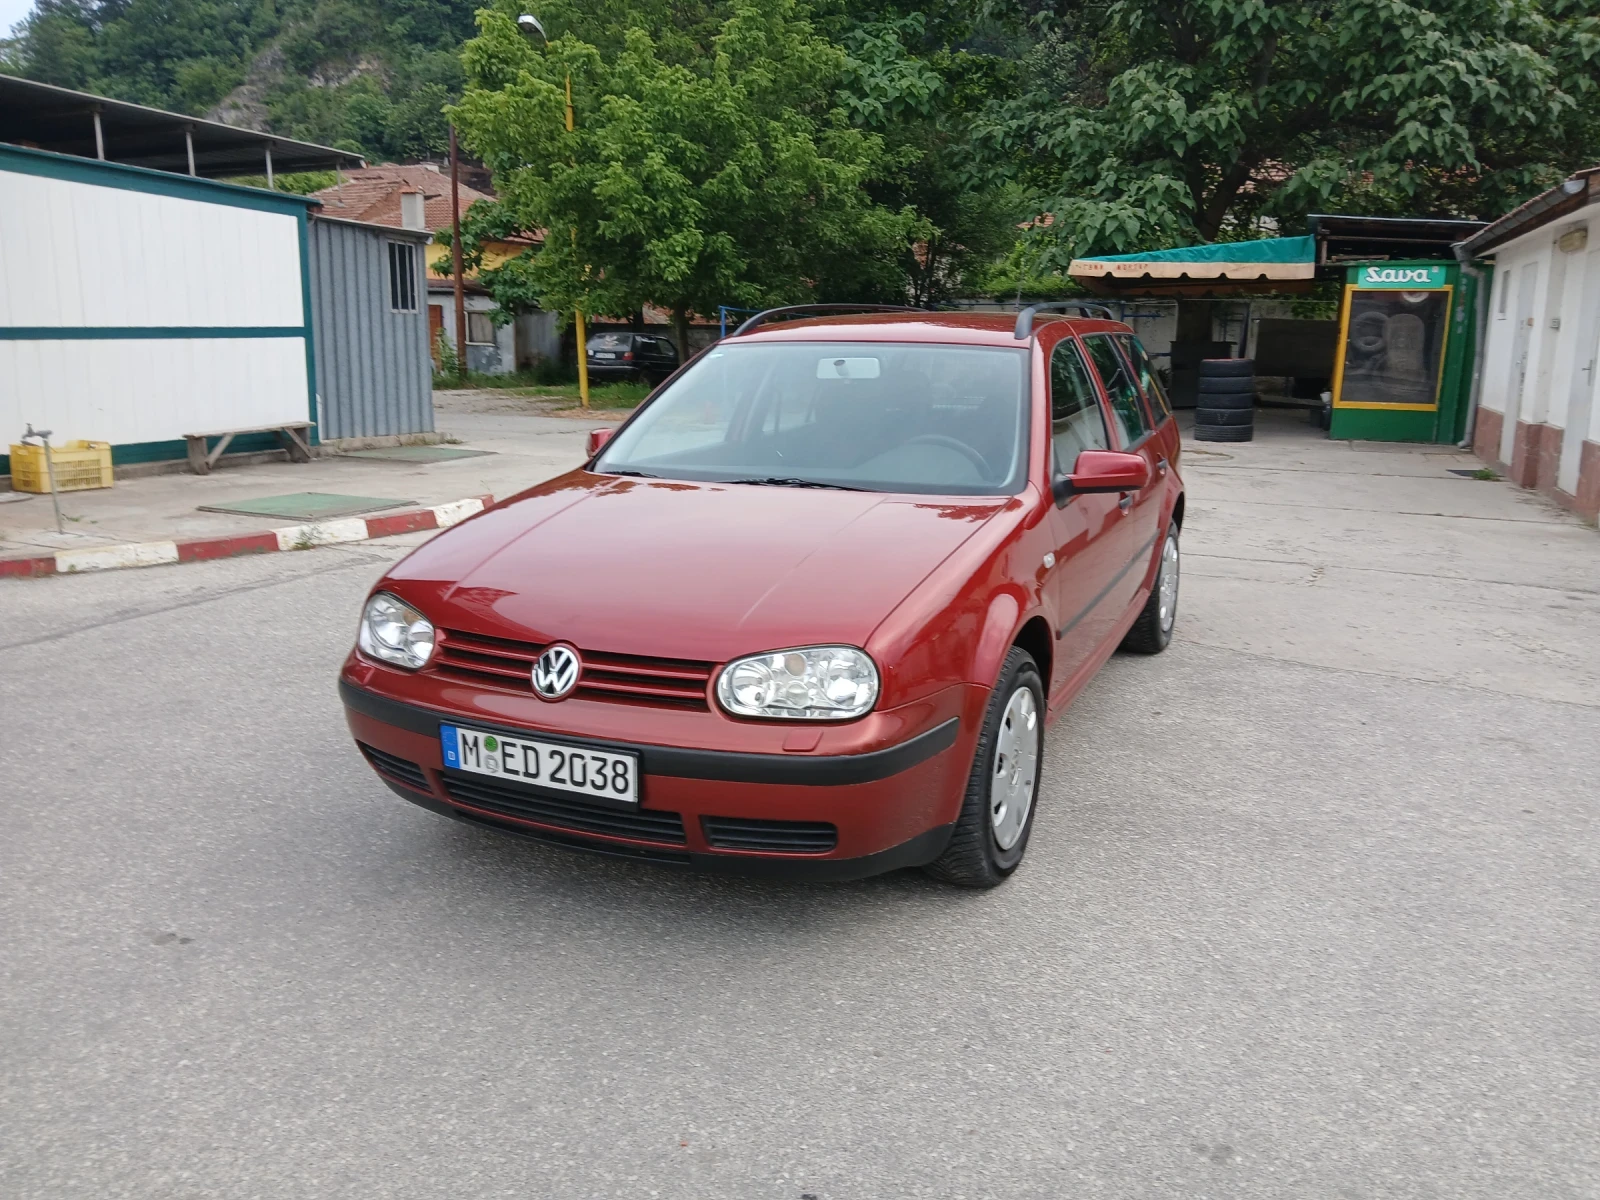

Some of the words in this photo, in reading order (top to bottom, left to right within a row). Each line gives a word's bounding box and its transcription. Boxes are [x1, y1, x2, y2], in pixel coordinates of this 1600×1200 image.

[1366, 266, 1431, 283] Sava
[462, 733, 481, 768] M
[502, 741, 540, 779] ED
[549, 749, 629, 794] 2038
